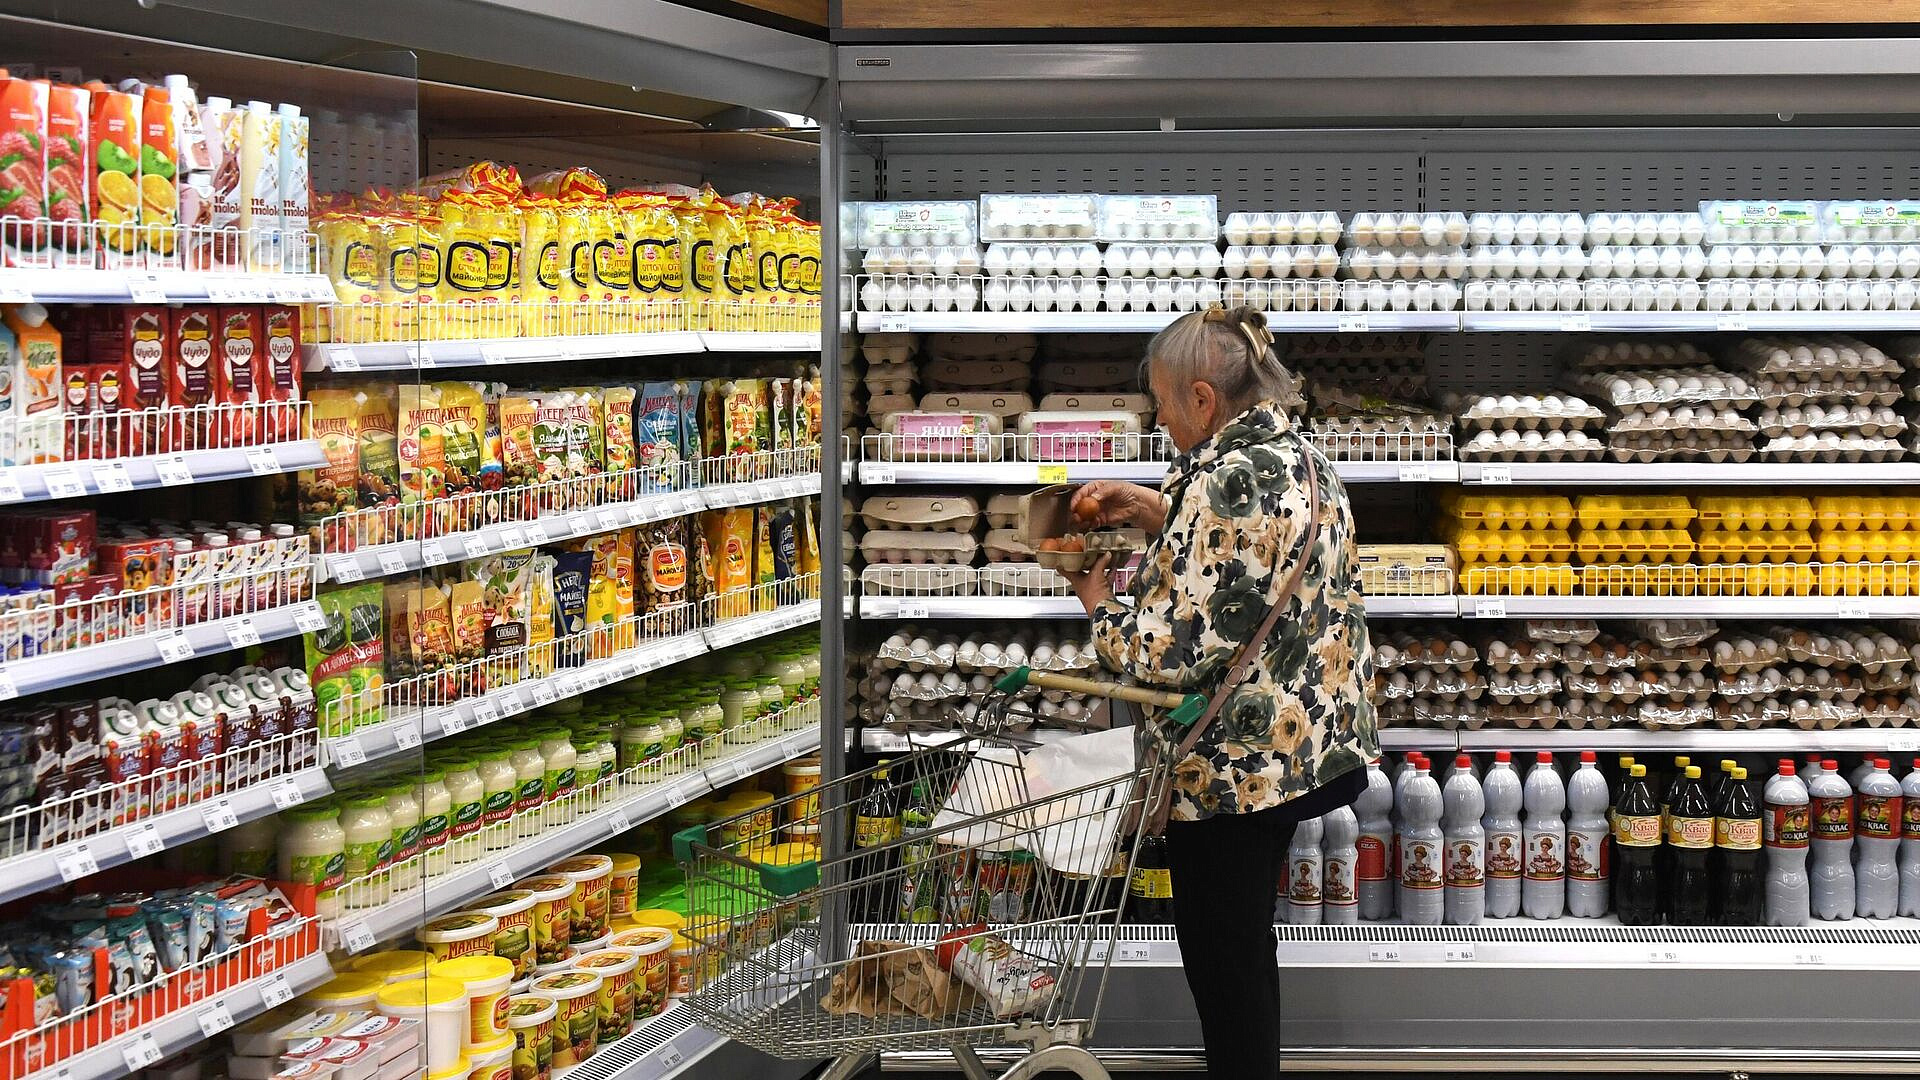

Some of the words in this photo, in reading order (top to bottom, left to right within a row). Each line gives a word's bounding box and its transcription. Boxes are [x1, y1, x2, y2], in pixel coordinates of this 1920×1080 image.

[251, 197, 265, 206] ne
[283, 199, 296, 208] ne
[135, 346, 160, 362] Чудо
[183, 345, 209, 362] Чудо
[227, 344, 252, 360] Чудо
[271, 341, 293, 357] Чудо
[1632, 822, 1658, 833] Квас
[1684, 822, 1711, 834] Квас
[1731, 823, 1758, 835] Квас
